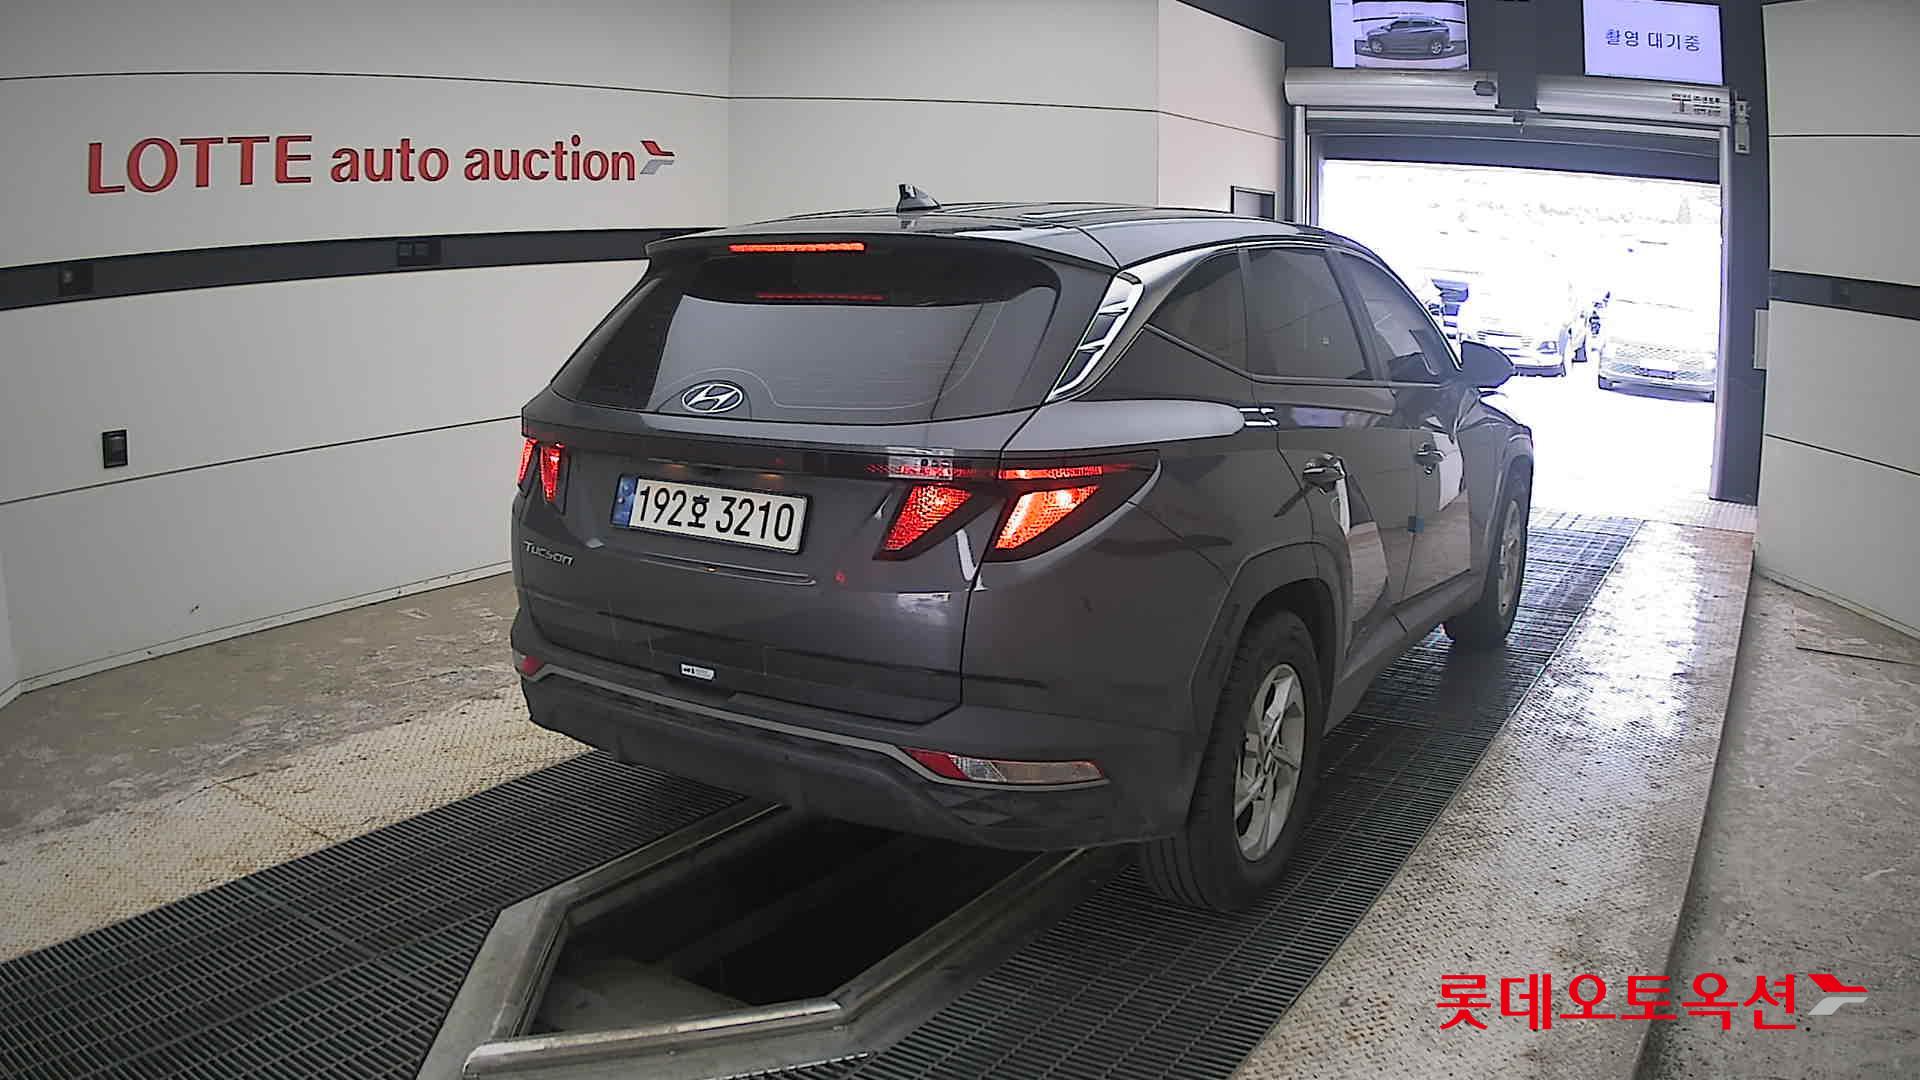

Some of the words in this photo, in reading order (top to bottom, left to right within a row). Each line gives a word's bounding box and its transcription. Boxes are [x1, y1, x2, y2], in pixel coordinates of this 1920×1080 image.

[1647, 32, 1700, 51] 대기중
[88, 135, 312, 193] LOTTE
[331, 139, 448, 182] auto
[464, 135, 636, 182] auction
[640, 486, 708, 528] 192호
[715, 496, 794, 541] 3210
